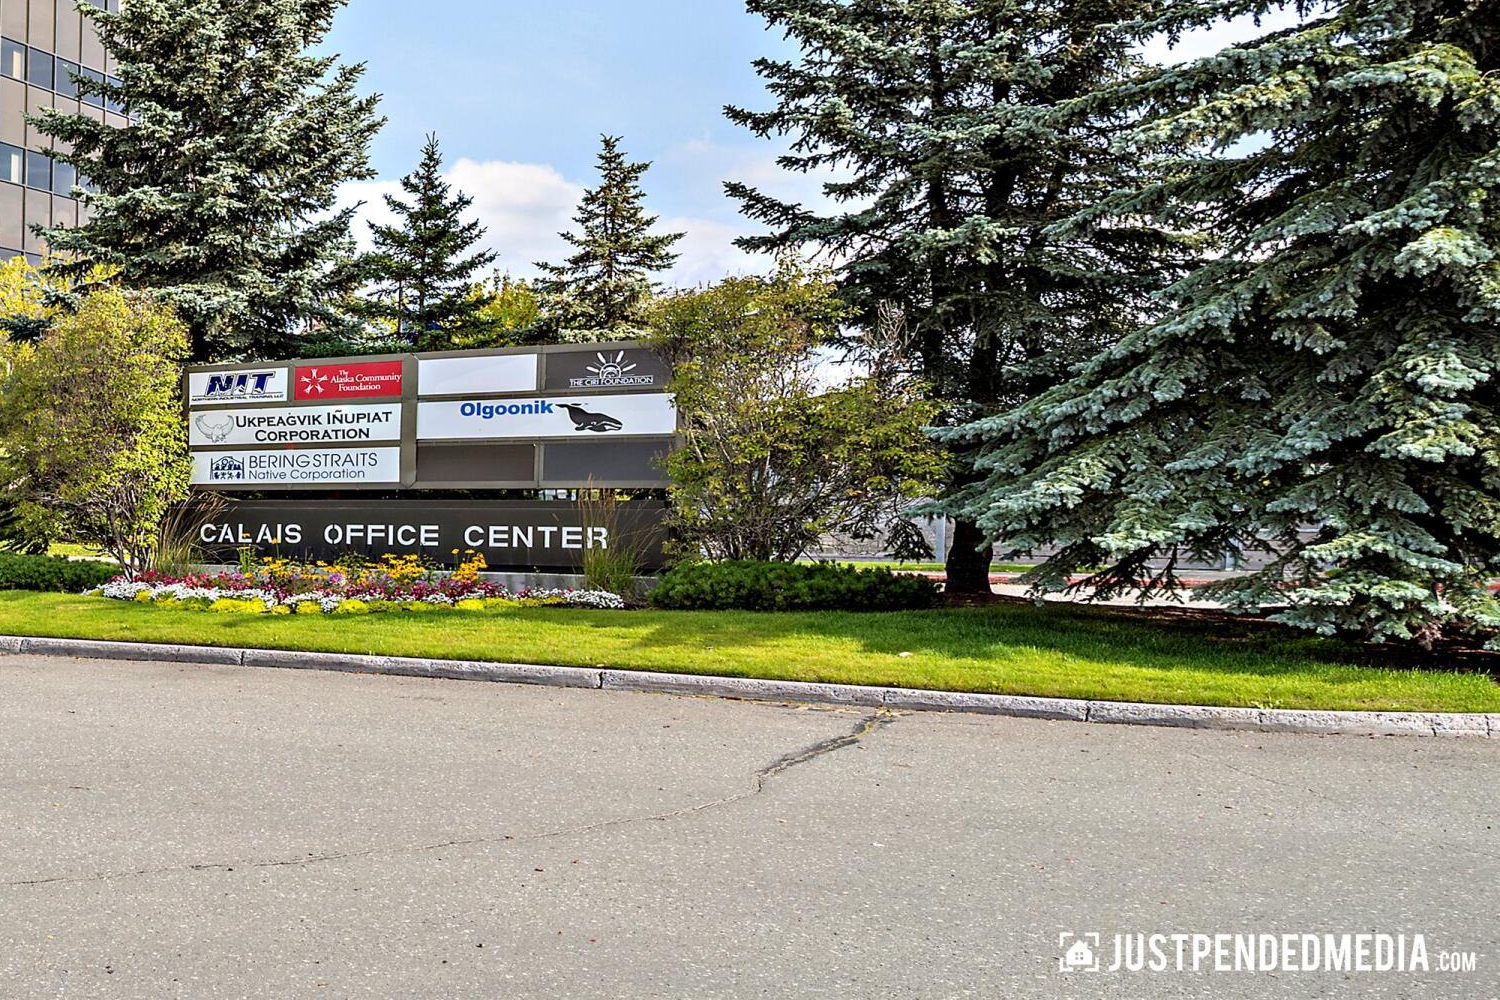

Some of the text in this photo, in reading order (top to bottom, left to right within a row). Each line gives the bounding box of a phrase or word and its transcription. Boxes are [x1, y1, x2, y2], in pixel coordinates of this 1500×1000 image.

[204, 371, 276, 396] NIT
[330, 372, 402, 383] Alaska Community
[585, 378, 599, 386] CIRI
[601, 376, 653, 385] FOUNDATION
[338, 383, 381, 391] Foundation
[460, 400, 553, 419] Olgoonik
[249, 452, 378, 469] BERING STRAITS
[248, 467, 365, 481] Native Corporation
[200, 523, 608, 549] CALAIS OFFICE CENTER
